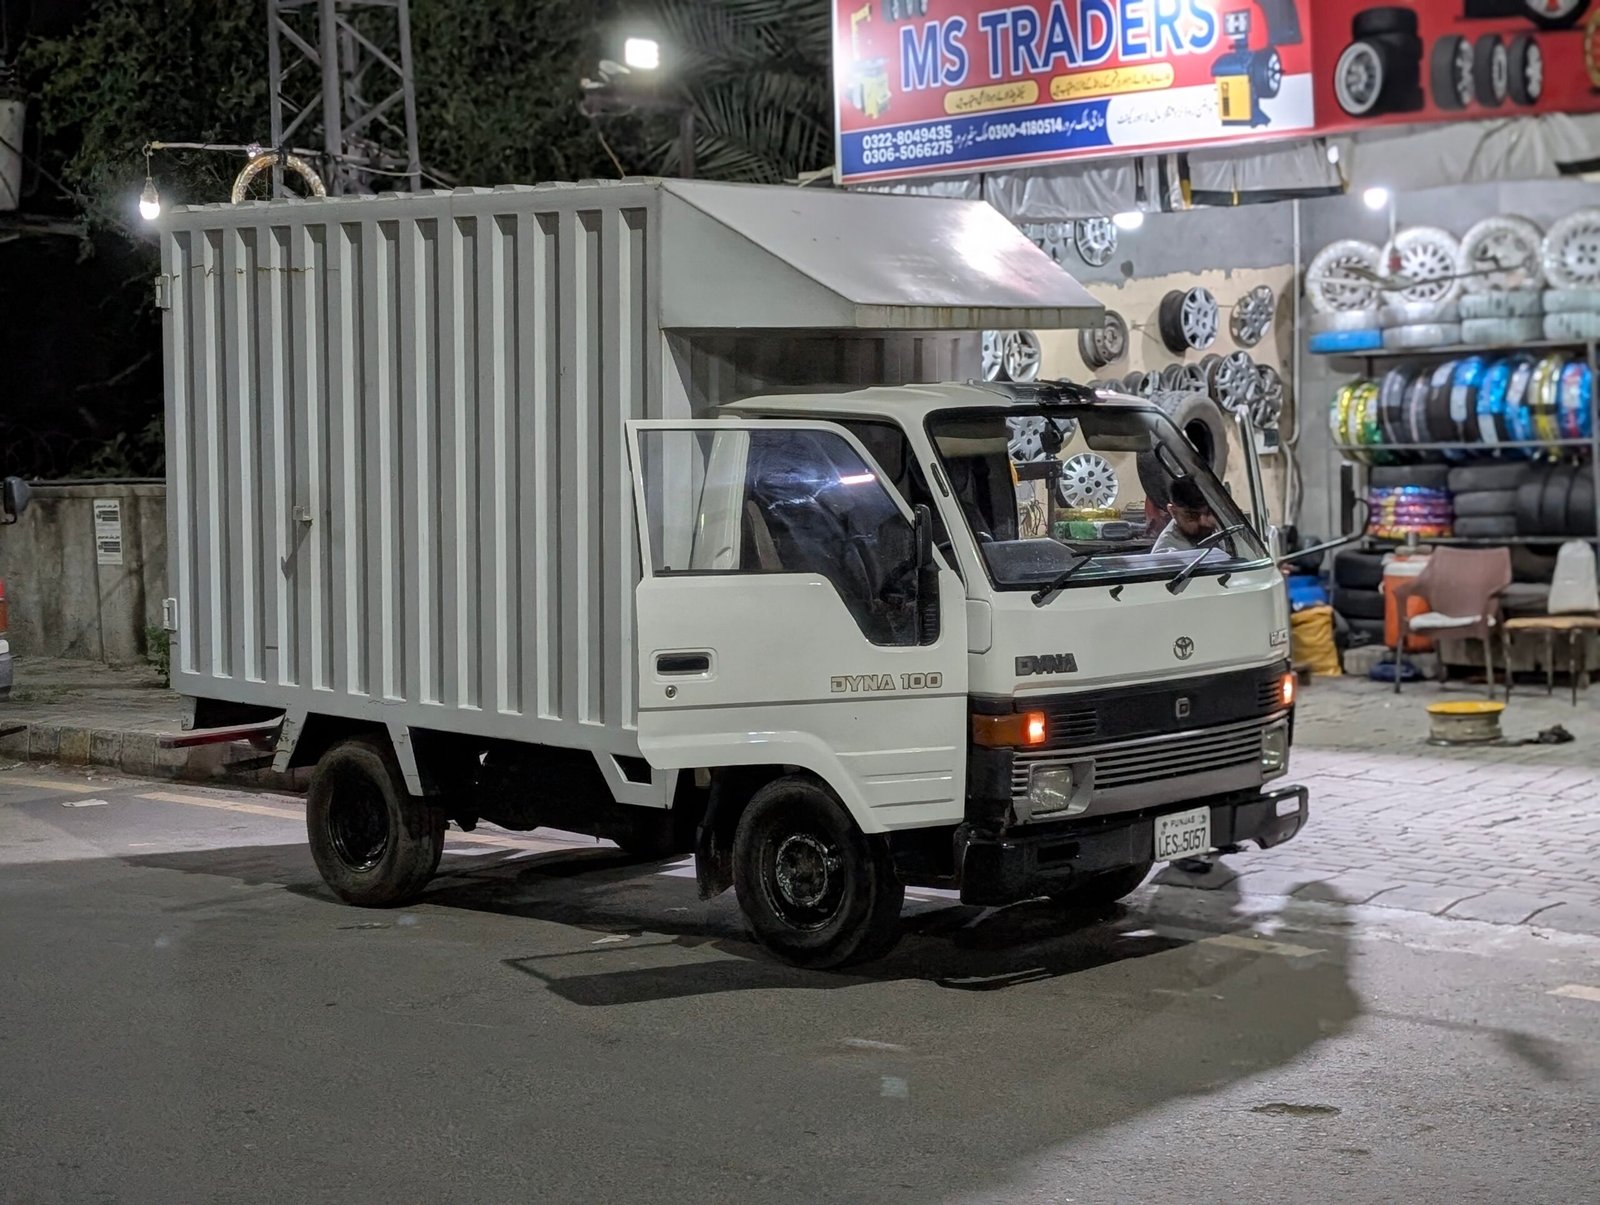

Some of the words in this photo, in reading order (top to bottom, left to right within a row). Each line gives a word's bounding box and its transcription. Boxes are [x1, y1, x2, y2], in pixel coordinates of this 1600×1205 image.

[901, 17, 968, 90] MS
[979, 0, 1216, 78] TRADERS
[862, 125, 953, 150] 0322-8049435
[988, 117, 1062, 140] 0300-4180514
[863, 140, 954, 165] 0306-5066275
[831, 673, 896, 692] DYNA
[900, 672, 943, 690] 100
